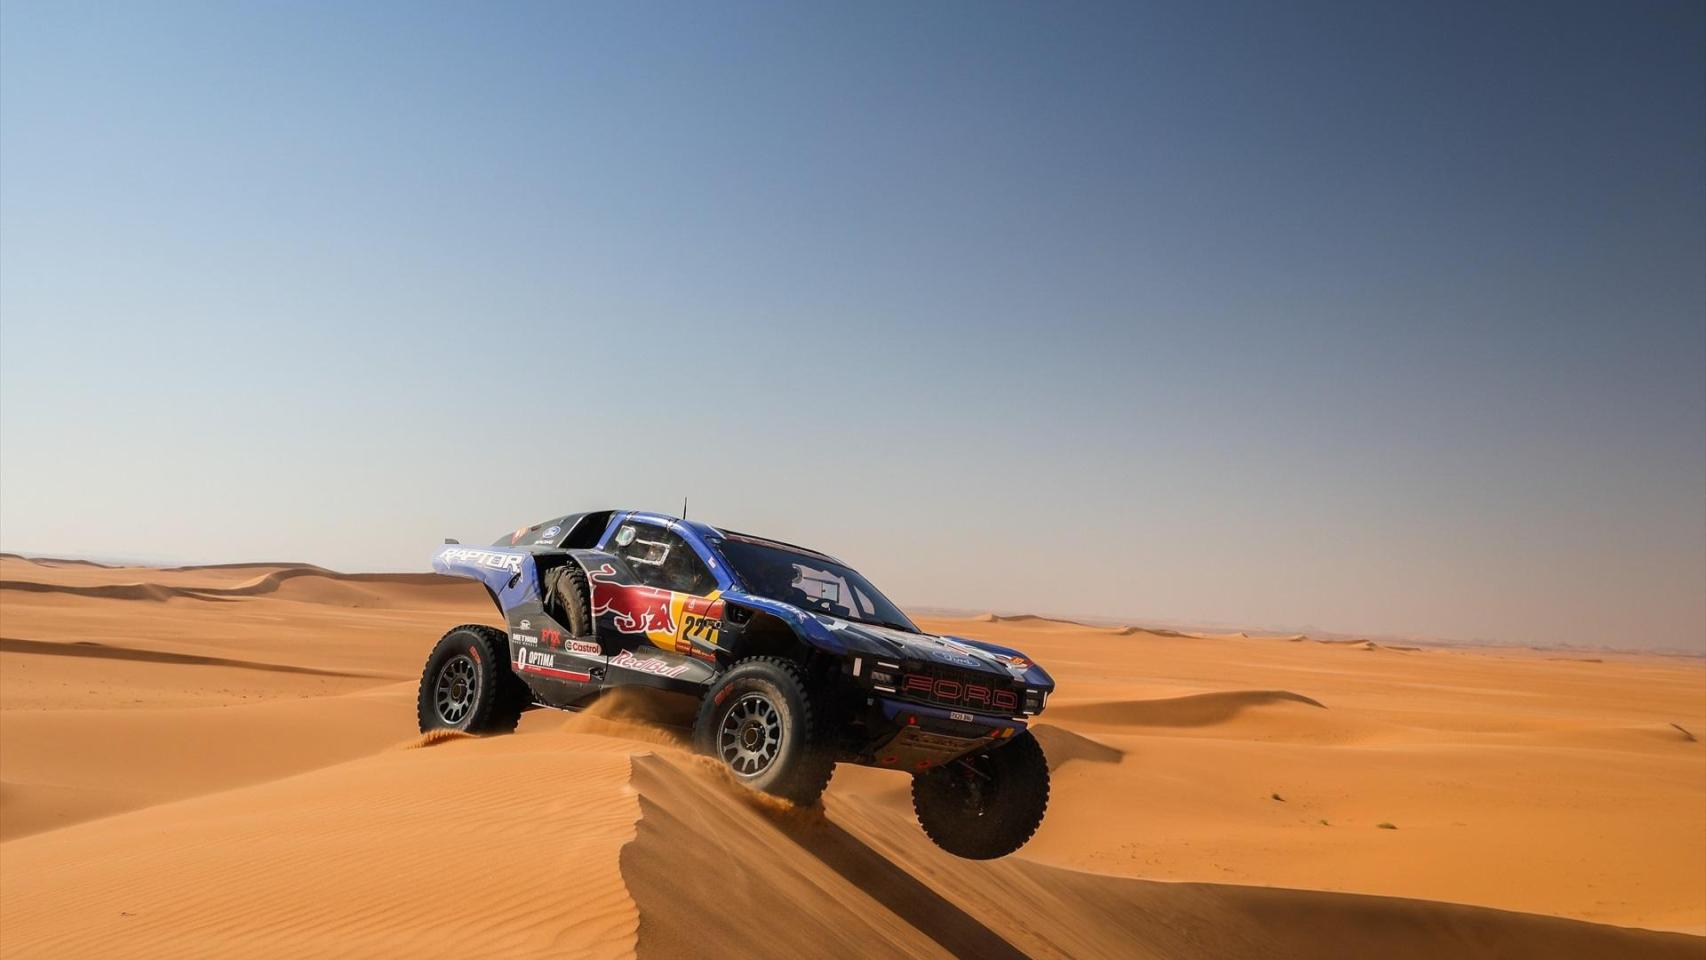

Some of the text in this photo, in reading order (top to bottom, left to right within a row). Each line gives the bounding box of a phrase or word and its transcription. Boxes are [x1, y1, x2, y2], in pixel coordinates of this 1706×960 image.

[440, 549, 524, 574] RAPTOR
[572, 643, 599, 653] Castrol
[529, 651, 554, 668] OPTIMA
[903, 674, 1018, 709] FORD
